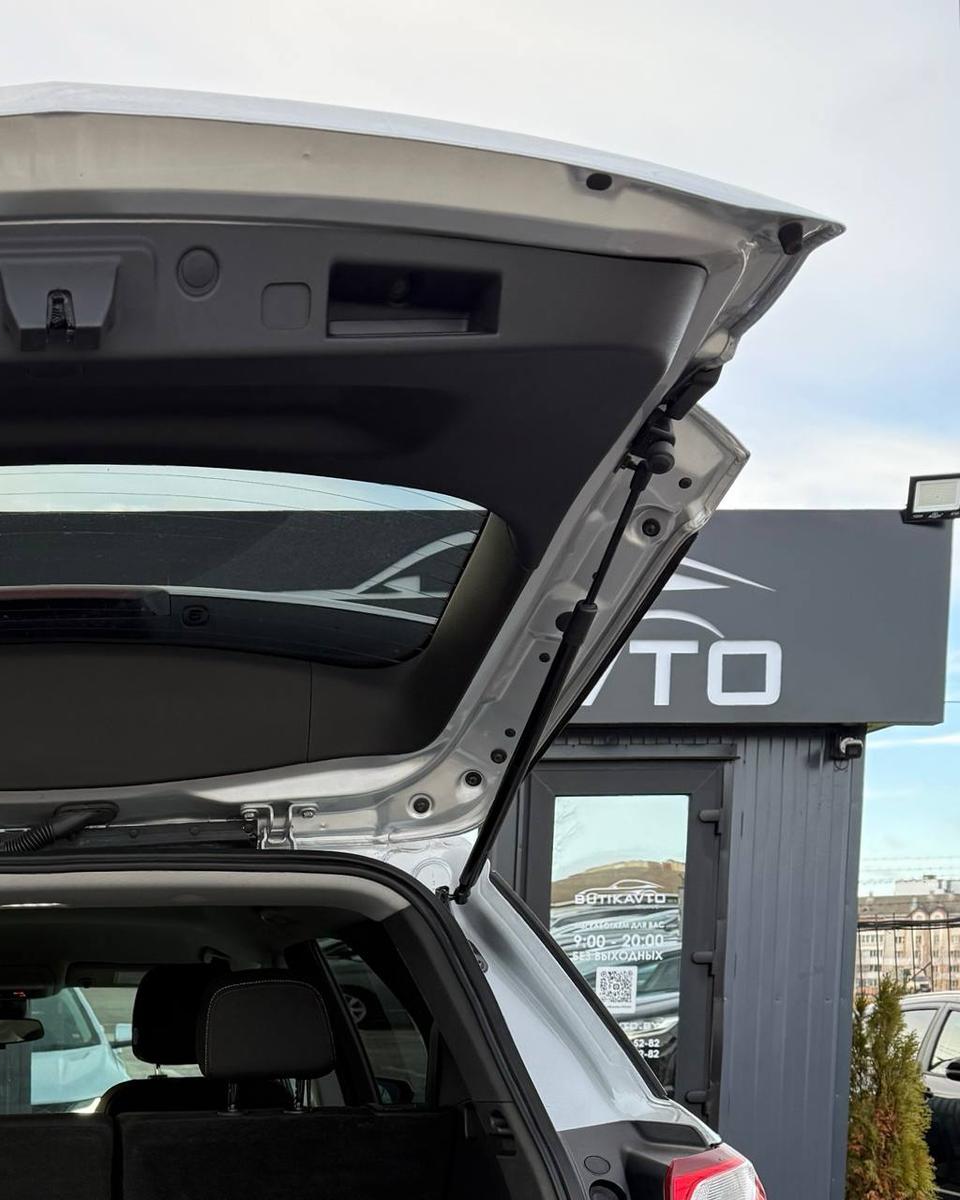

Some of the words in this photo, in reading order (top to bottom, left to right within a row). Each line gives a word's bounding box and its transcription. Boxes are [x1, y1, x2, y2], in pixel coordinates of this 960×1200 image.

[574, 893, 666, 905] BUTIKAVTO
[648, 921, 665, 929] ВАС
[573, 935, 606, 948] 9:00
[622, 934, 665, 947] 20:00
[572, 951, 592, 961] БЕЗ
[595, 950, 664, 962] ВЫХОДНЫХ
